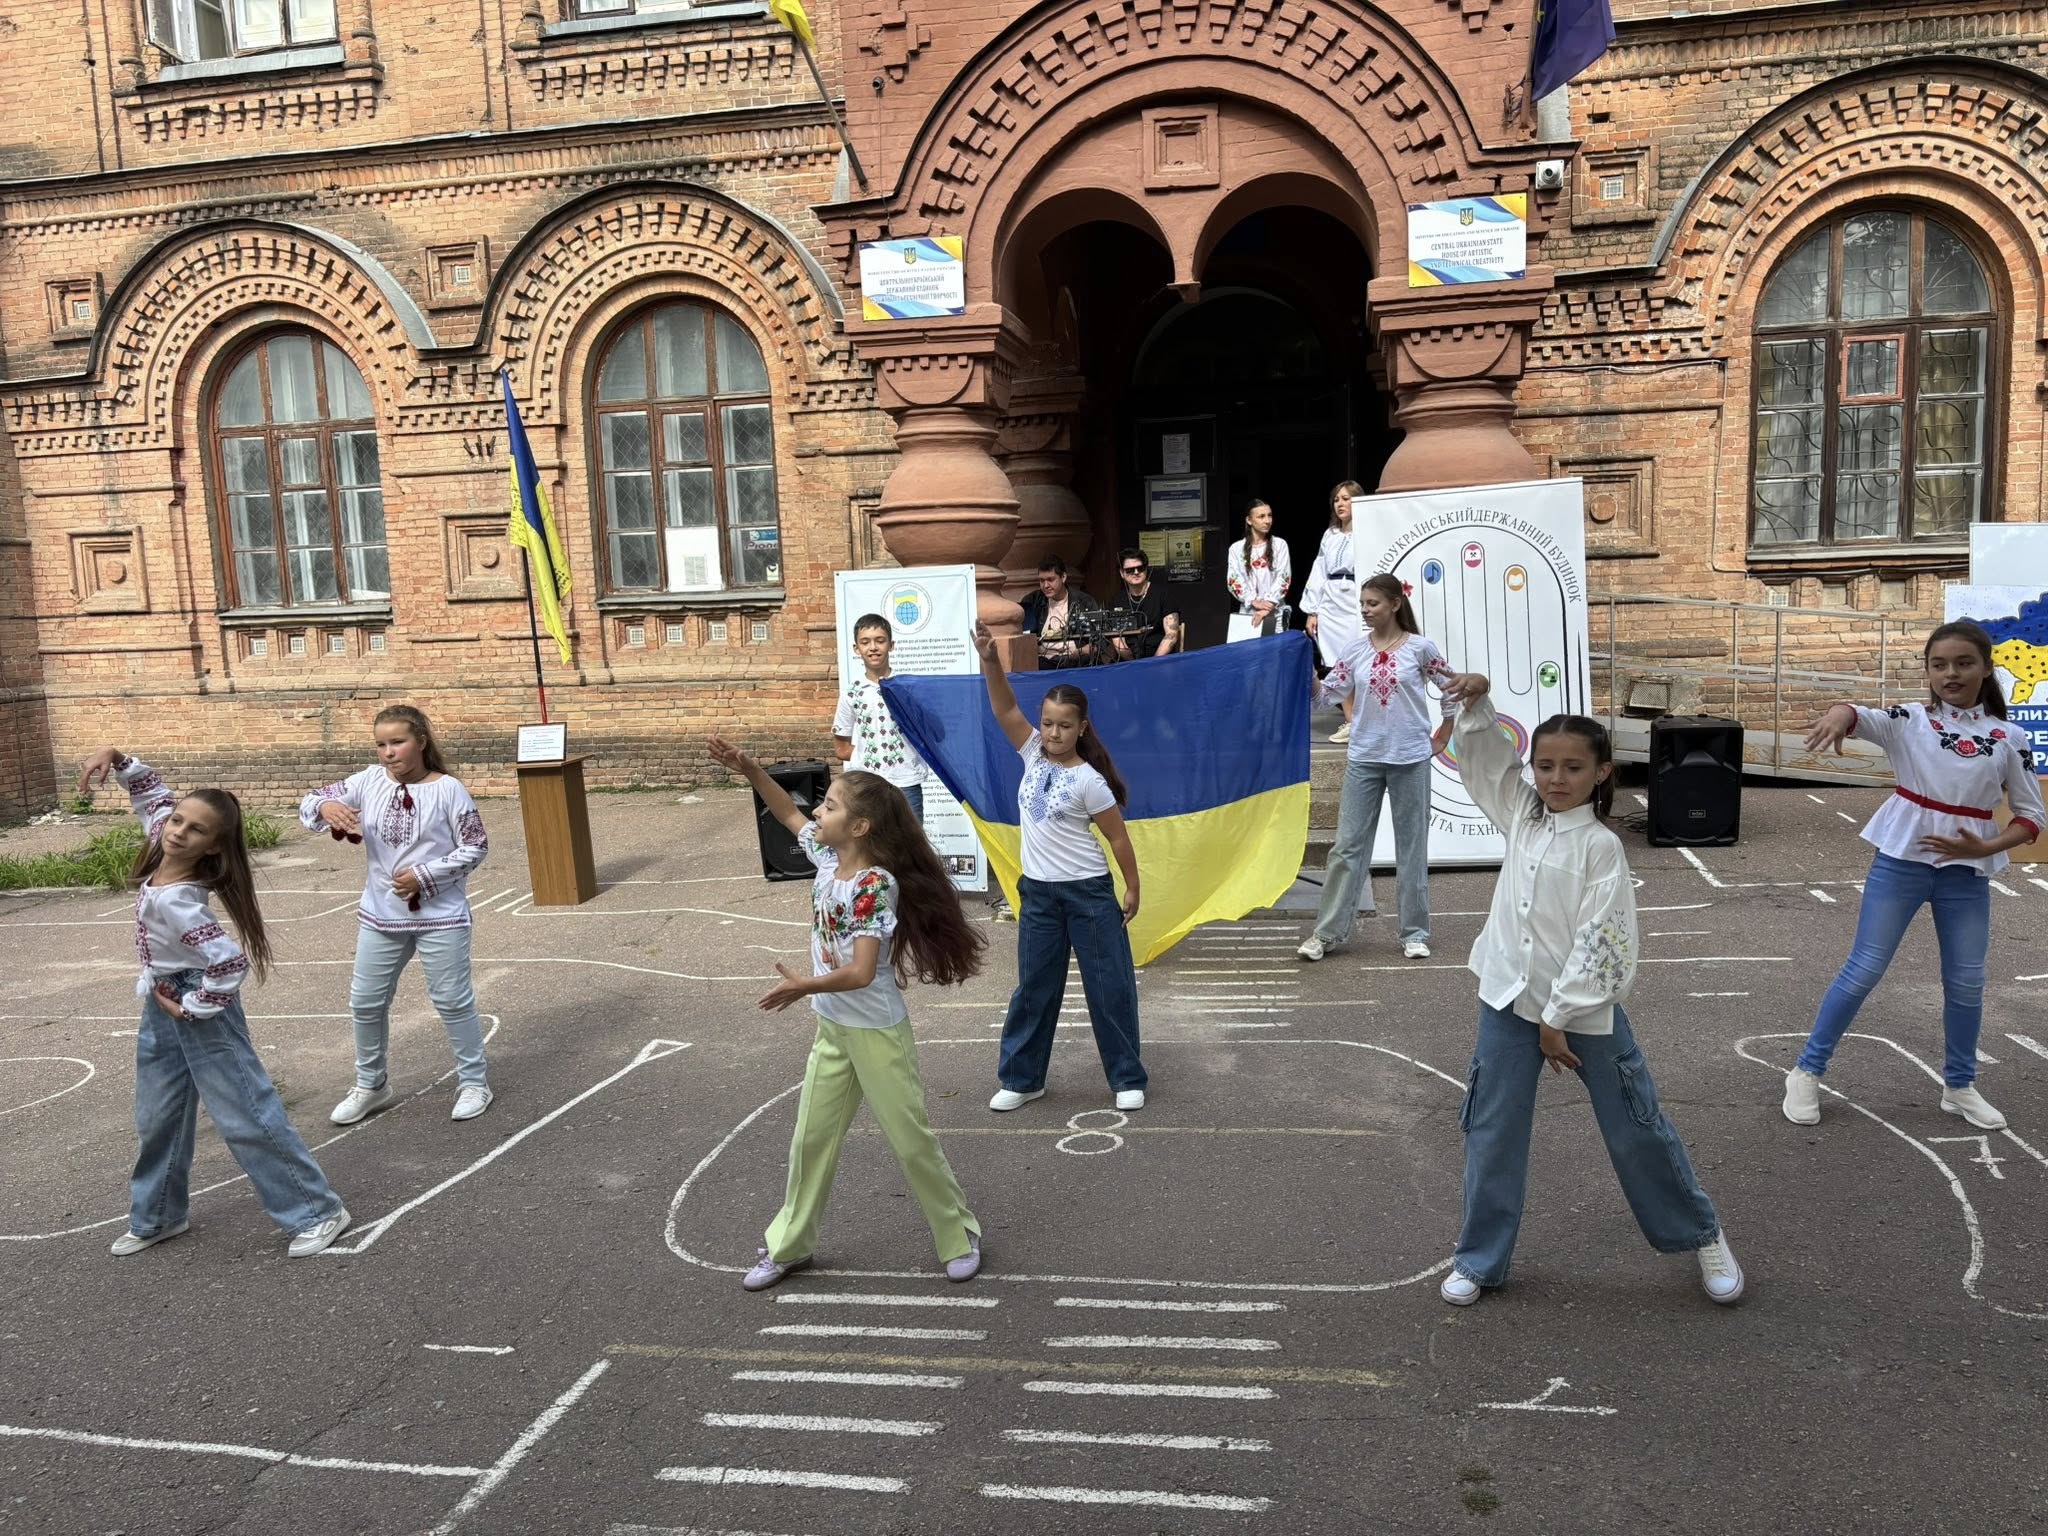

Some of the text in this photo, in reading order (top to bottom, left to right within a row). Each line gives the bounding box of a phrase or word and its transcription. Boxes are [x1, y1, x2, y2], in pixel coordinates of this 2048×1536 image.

[1431, 237, 1504, 251] CENTRAL UKRAINIAN STATE
[1441, 250, 1460, 259] HOUSE
[1467, 248, 1493, 257] ARTISTIC
[1431, 256, 1505, 269] AND TECHNICAL CREATIVITY
[1549, 545, 1582, 604] БУДИНОК
[1439, 818, 1453, 833] ТА
